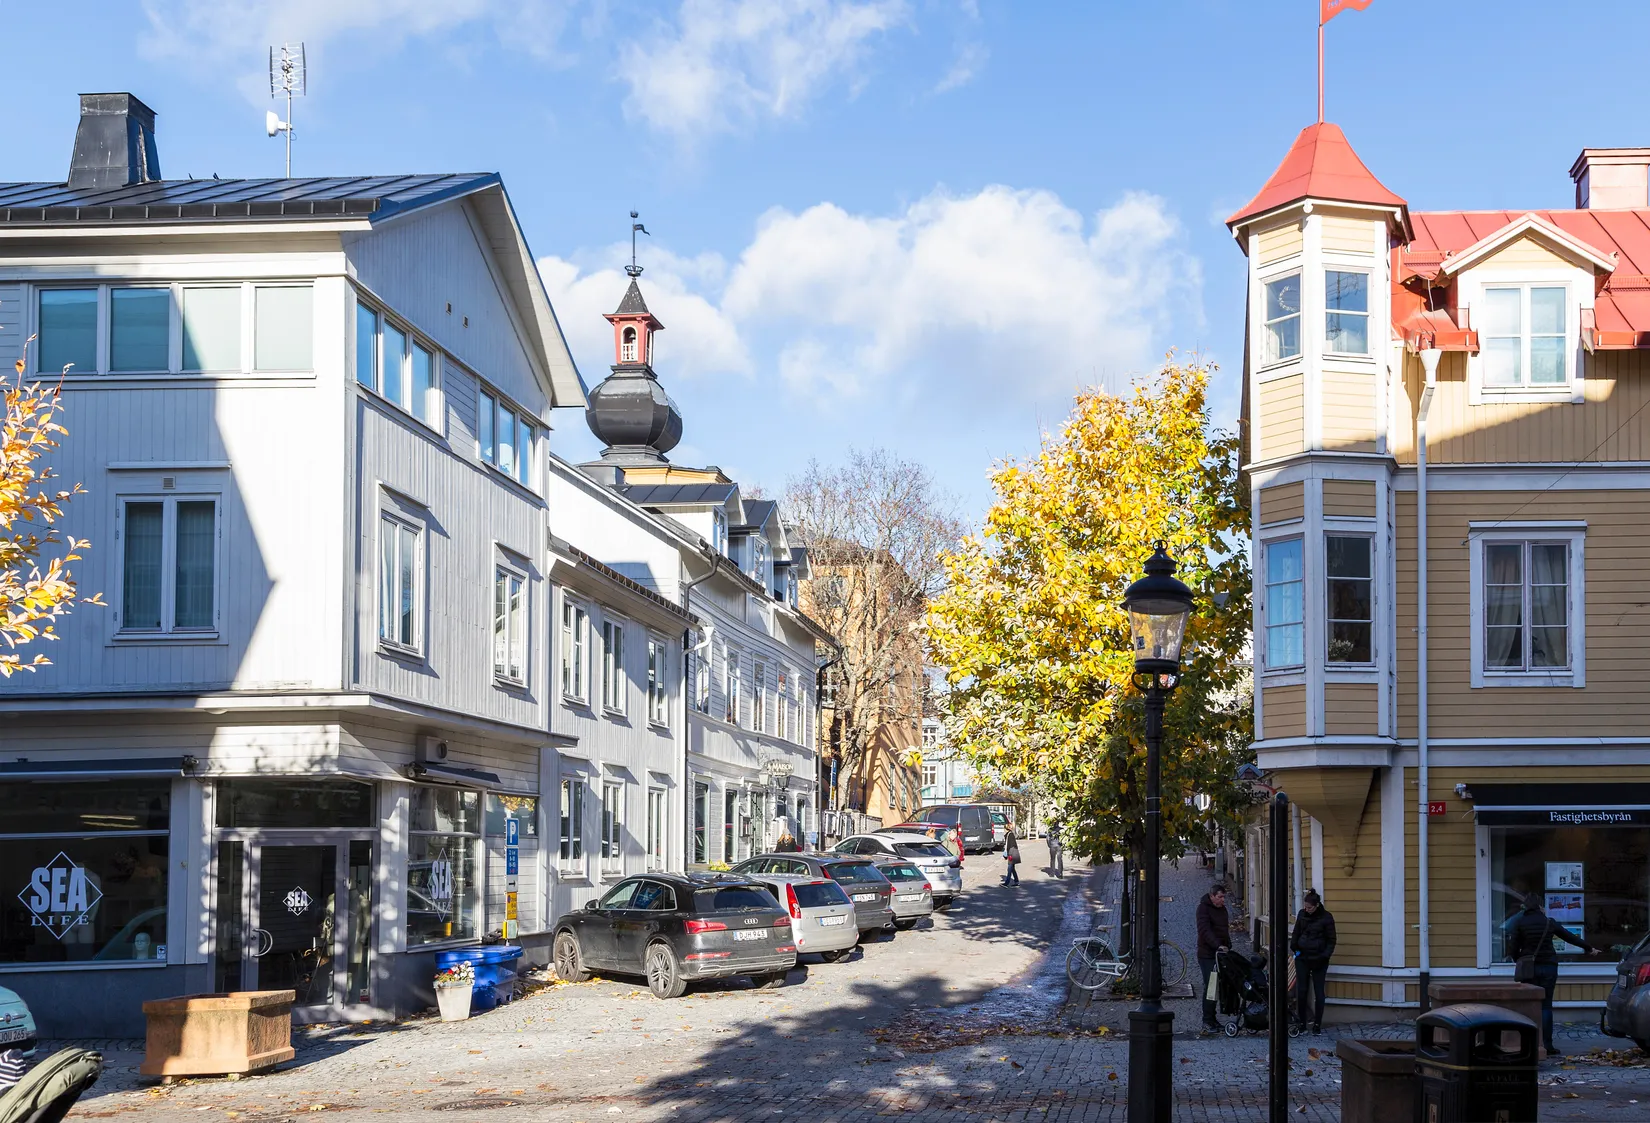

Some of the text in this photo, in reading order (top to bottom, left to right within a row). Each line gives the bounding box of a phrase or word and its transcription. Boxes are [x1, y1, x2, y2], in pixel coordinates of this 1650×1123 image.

[1549, 811, 1632, 825] Fastighetsbyrån
[509, 821, 517, 844] P
[432, 860, 452, 899] SEA
[31, 867, 88, 913] SEA
[287, 891, 308, 907] SEA
[31, 915, 90, 926] LIFE
